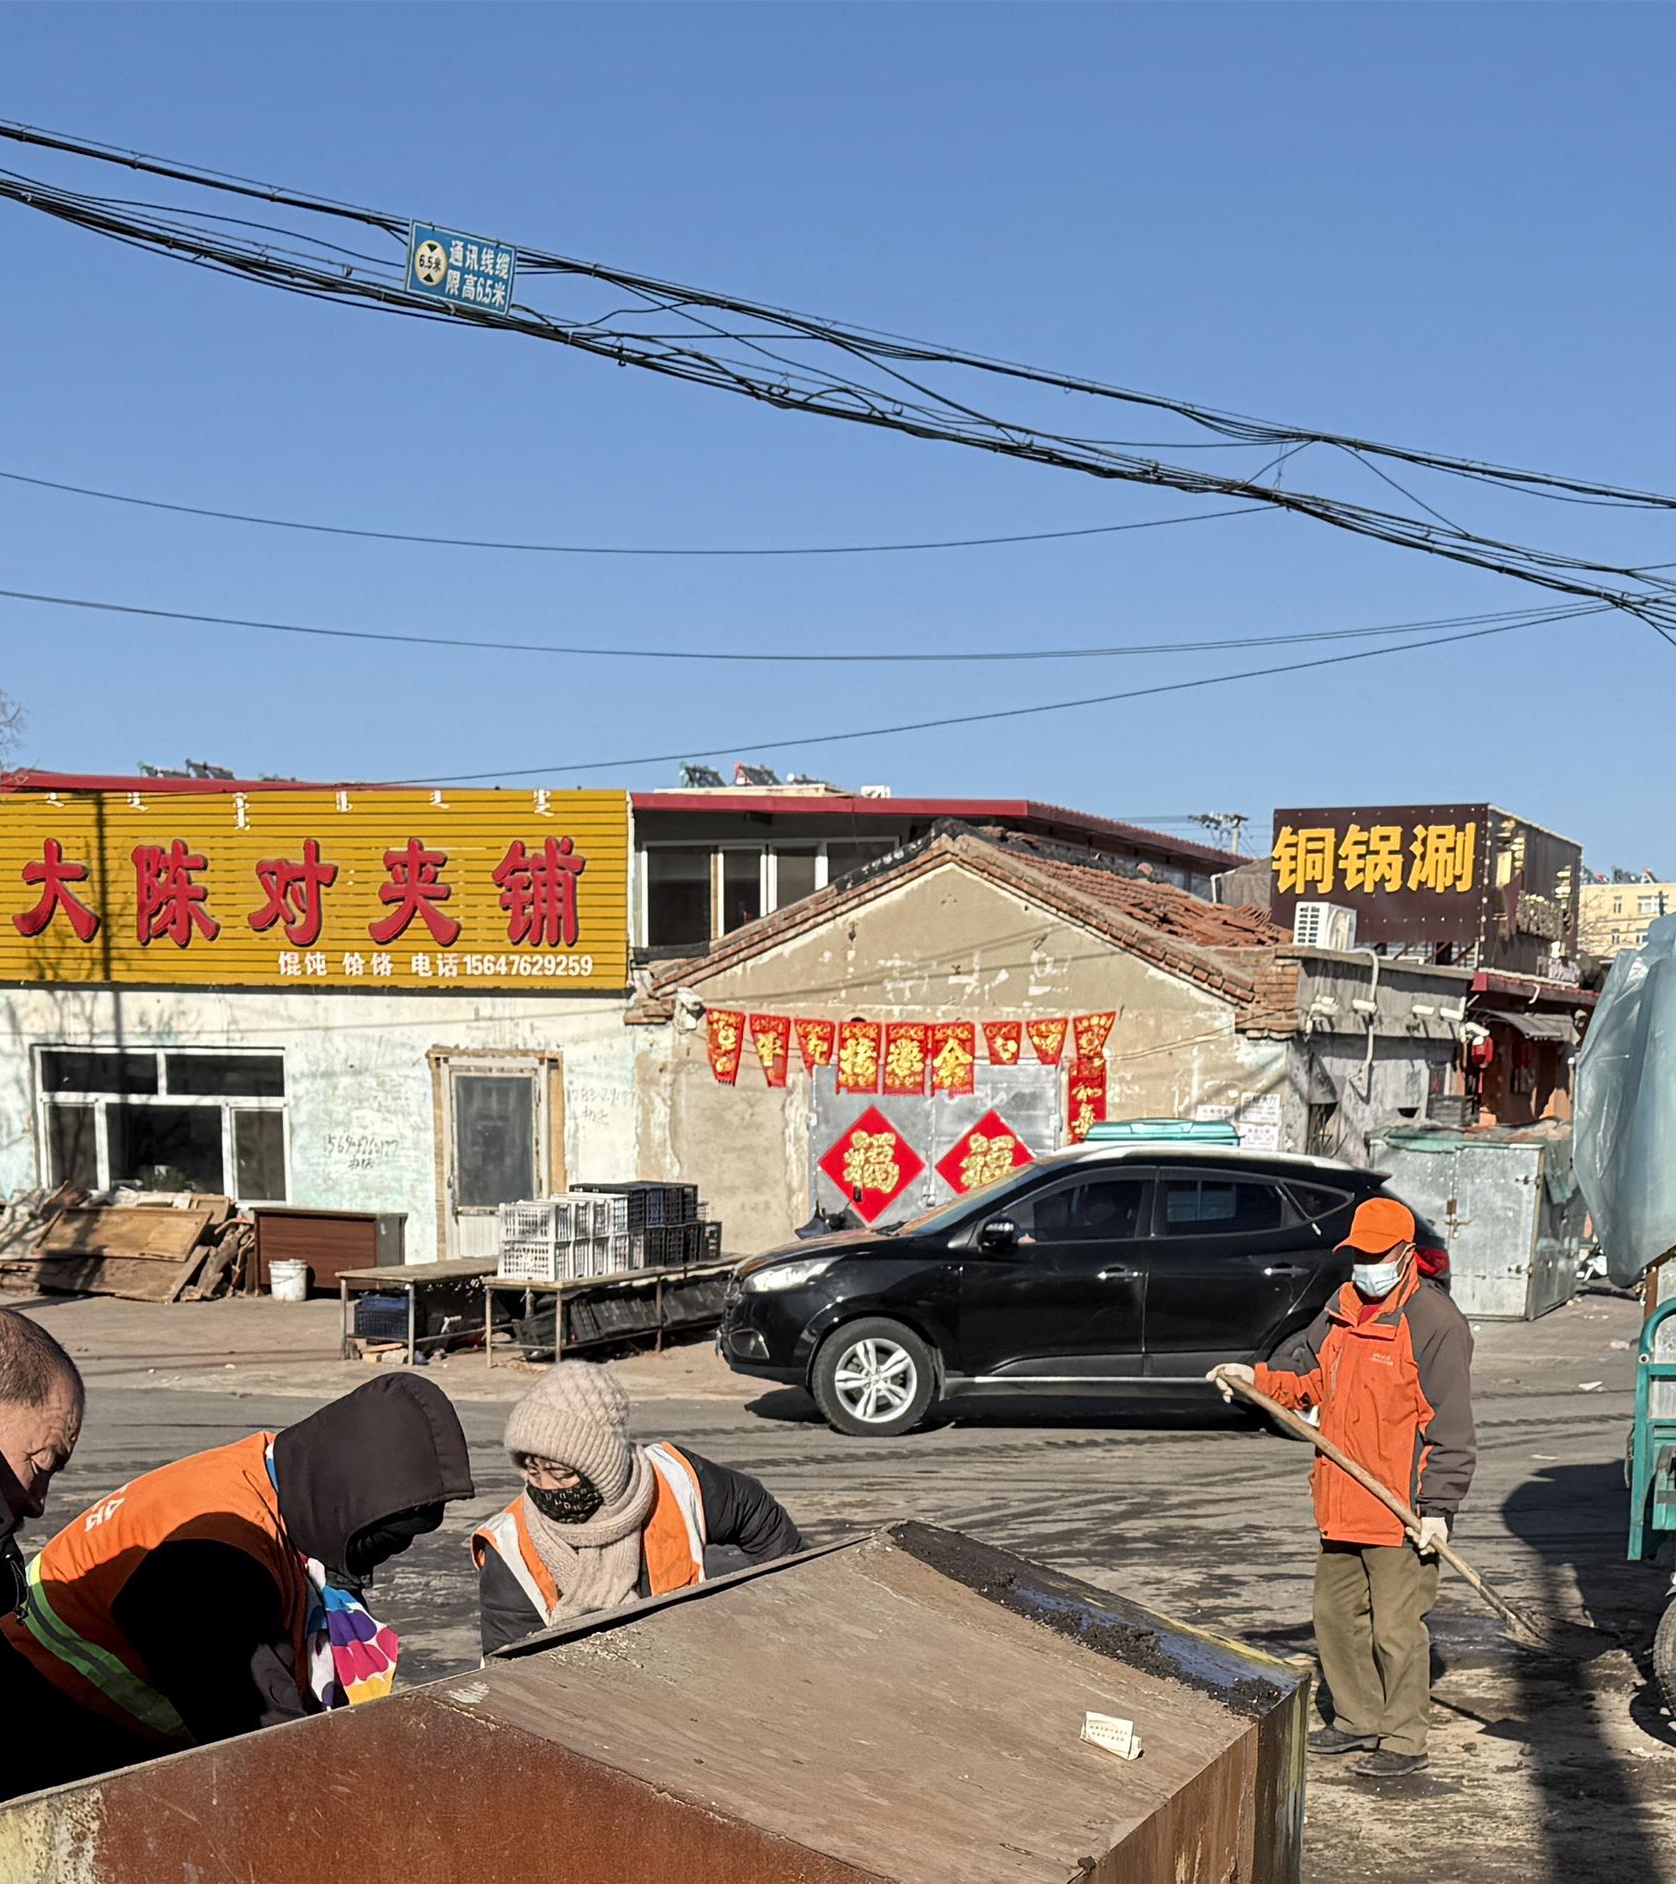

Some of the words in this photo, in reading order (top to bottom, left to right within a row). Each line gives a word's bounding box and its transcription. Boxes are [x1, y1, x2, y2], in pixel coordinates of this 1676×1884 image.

[11, 835, 587, 949] 大陈对夹铺
[1271, 822, 1477, 895] 铜锅涮
[278, 951, 327, 977] 馄饨
